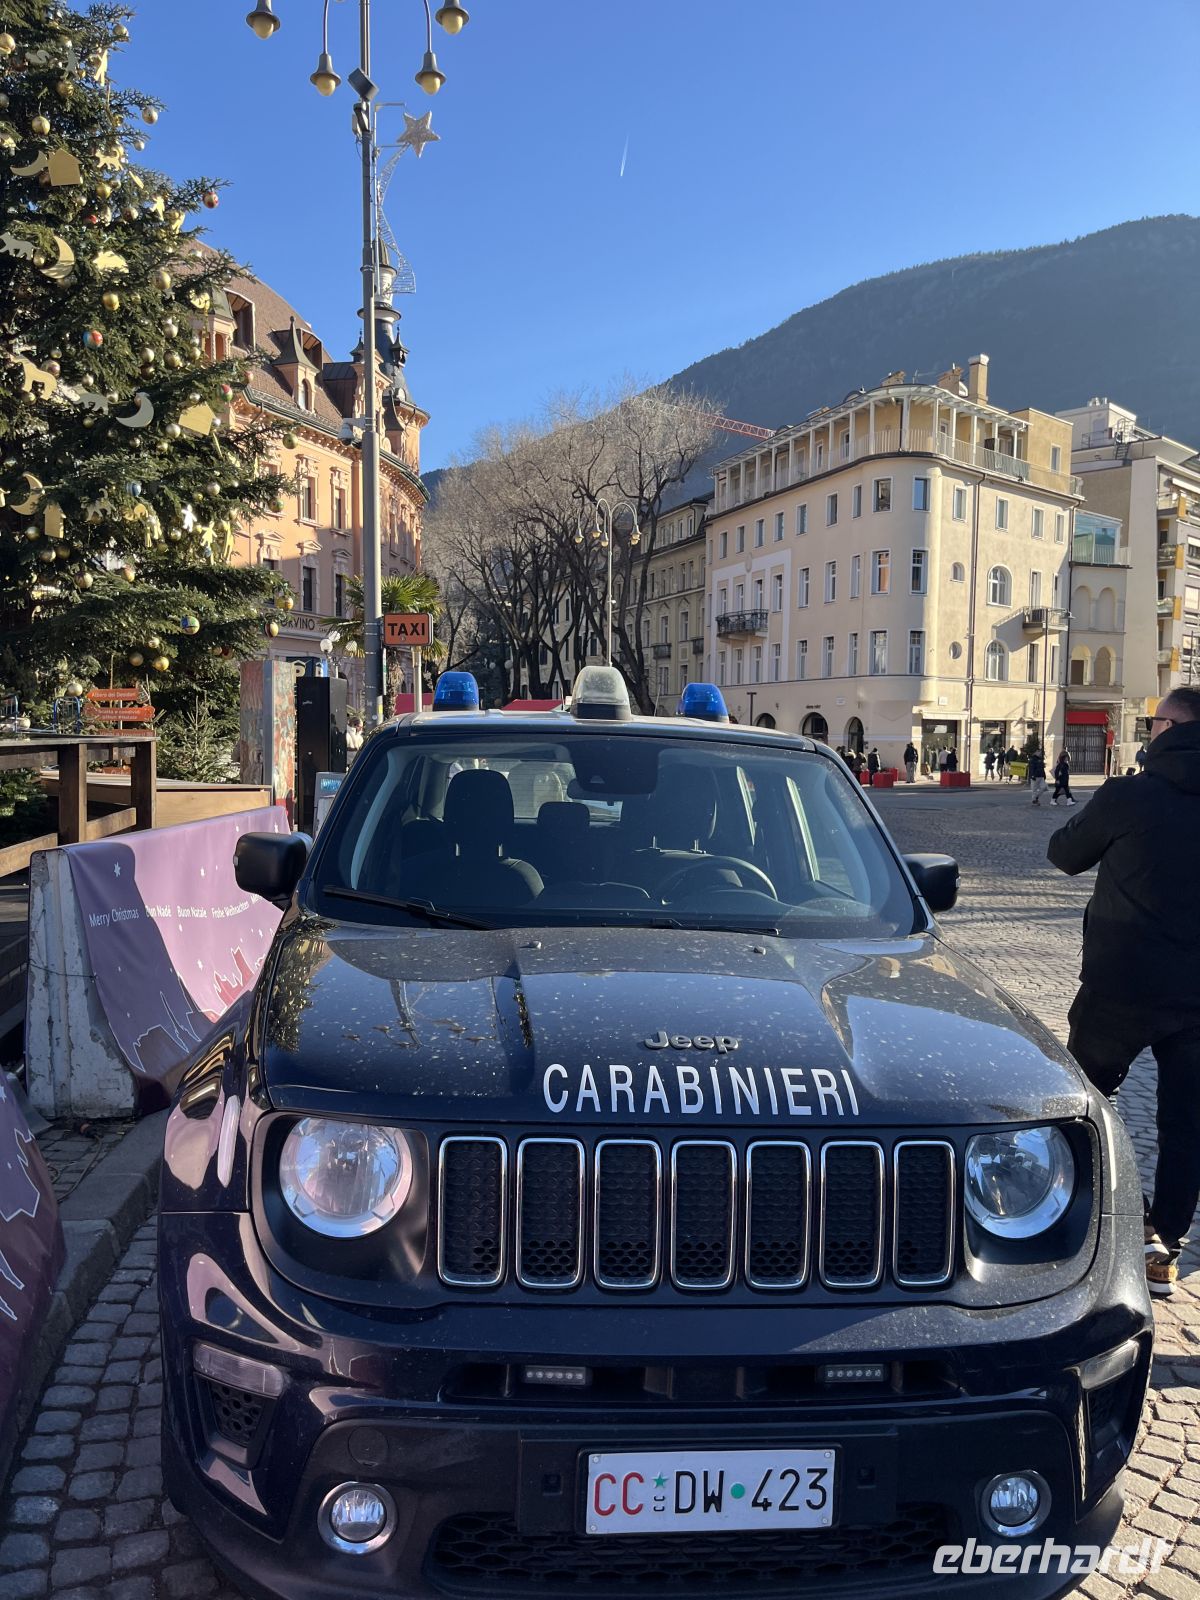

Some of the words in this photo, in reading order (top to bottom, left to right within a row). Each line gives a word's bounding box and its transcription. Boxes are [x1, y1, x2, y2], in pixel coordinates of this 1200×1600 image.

[387, 622, 426, 637] TAXI
[88, 913, 110, 927] Merry
[111, 907, 139, 922] Christmas
[177, 906, 190, 917] Buon
[190, 906, 208, 918] Natale
[211, 907, 225, 919] Frohe
[223, 900, 250, 917] Weihnachten
[644, 1030, 739, 1054] Jeep
[543, 1063, 859, 1116] CARABINIERI
[594, 1472, 644, 1517] CC
[674, 1470, 725, 1514] DW
[751, 1467, 828, 1512] 423
